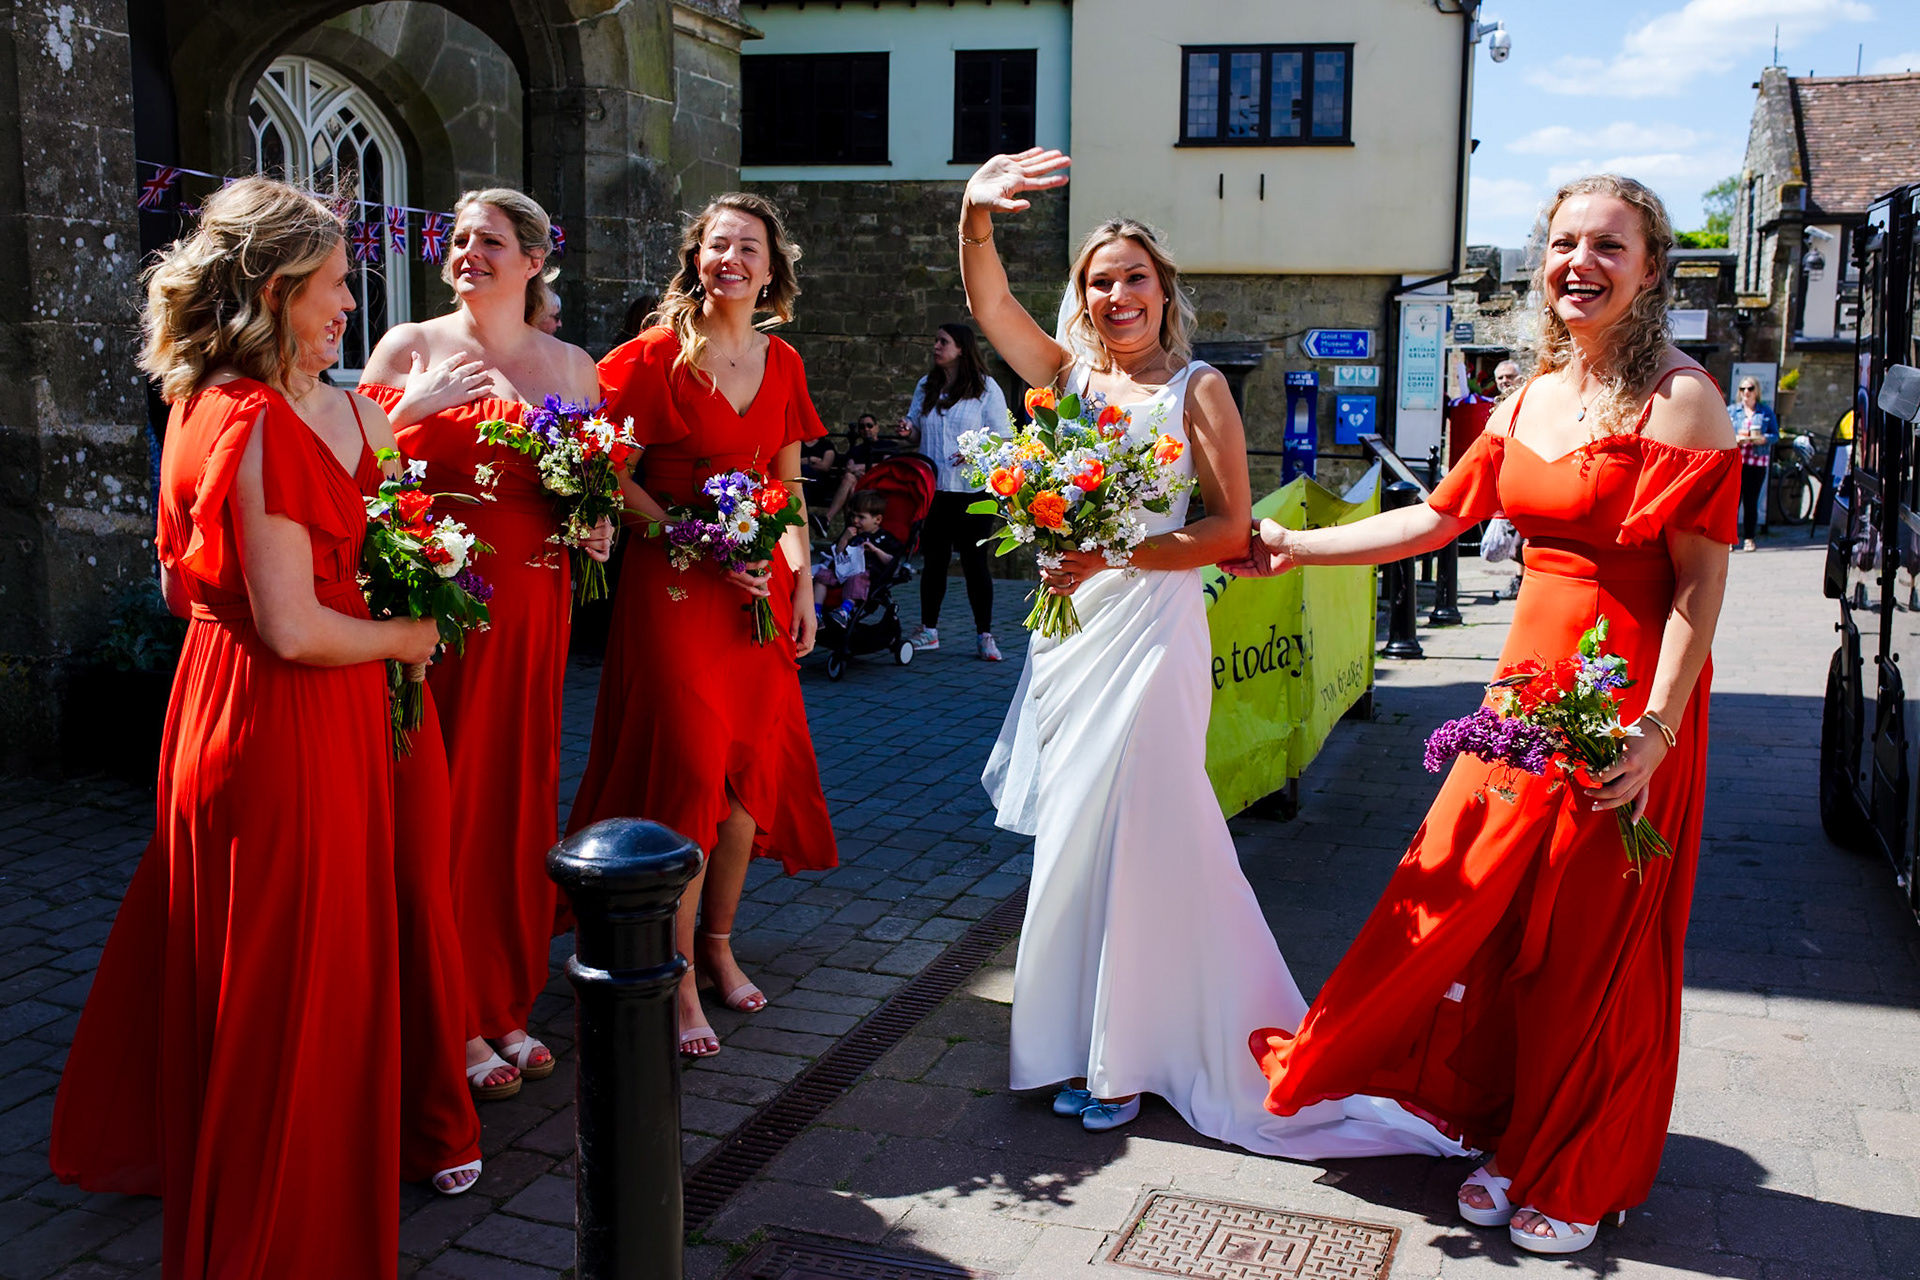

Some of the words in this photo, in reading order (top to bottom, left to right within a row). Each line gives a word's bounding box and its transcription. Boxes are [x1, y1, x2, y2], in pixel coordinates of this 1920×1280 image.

[1320, 332, 1338, 340] Gold
[1340, 332, 1353, 340] Hill
[1320, 340, 1350, 348] Museum
[1332, 347, 1354, 355] James
